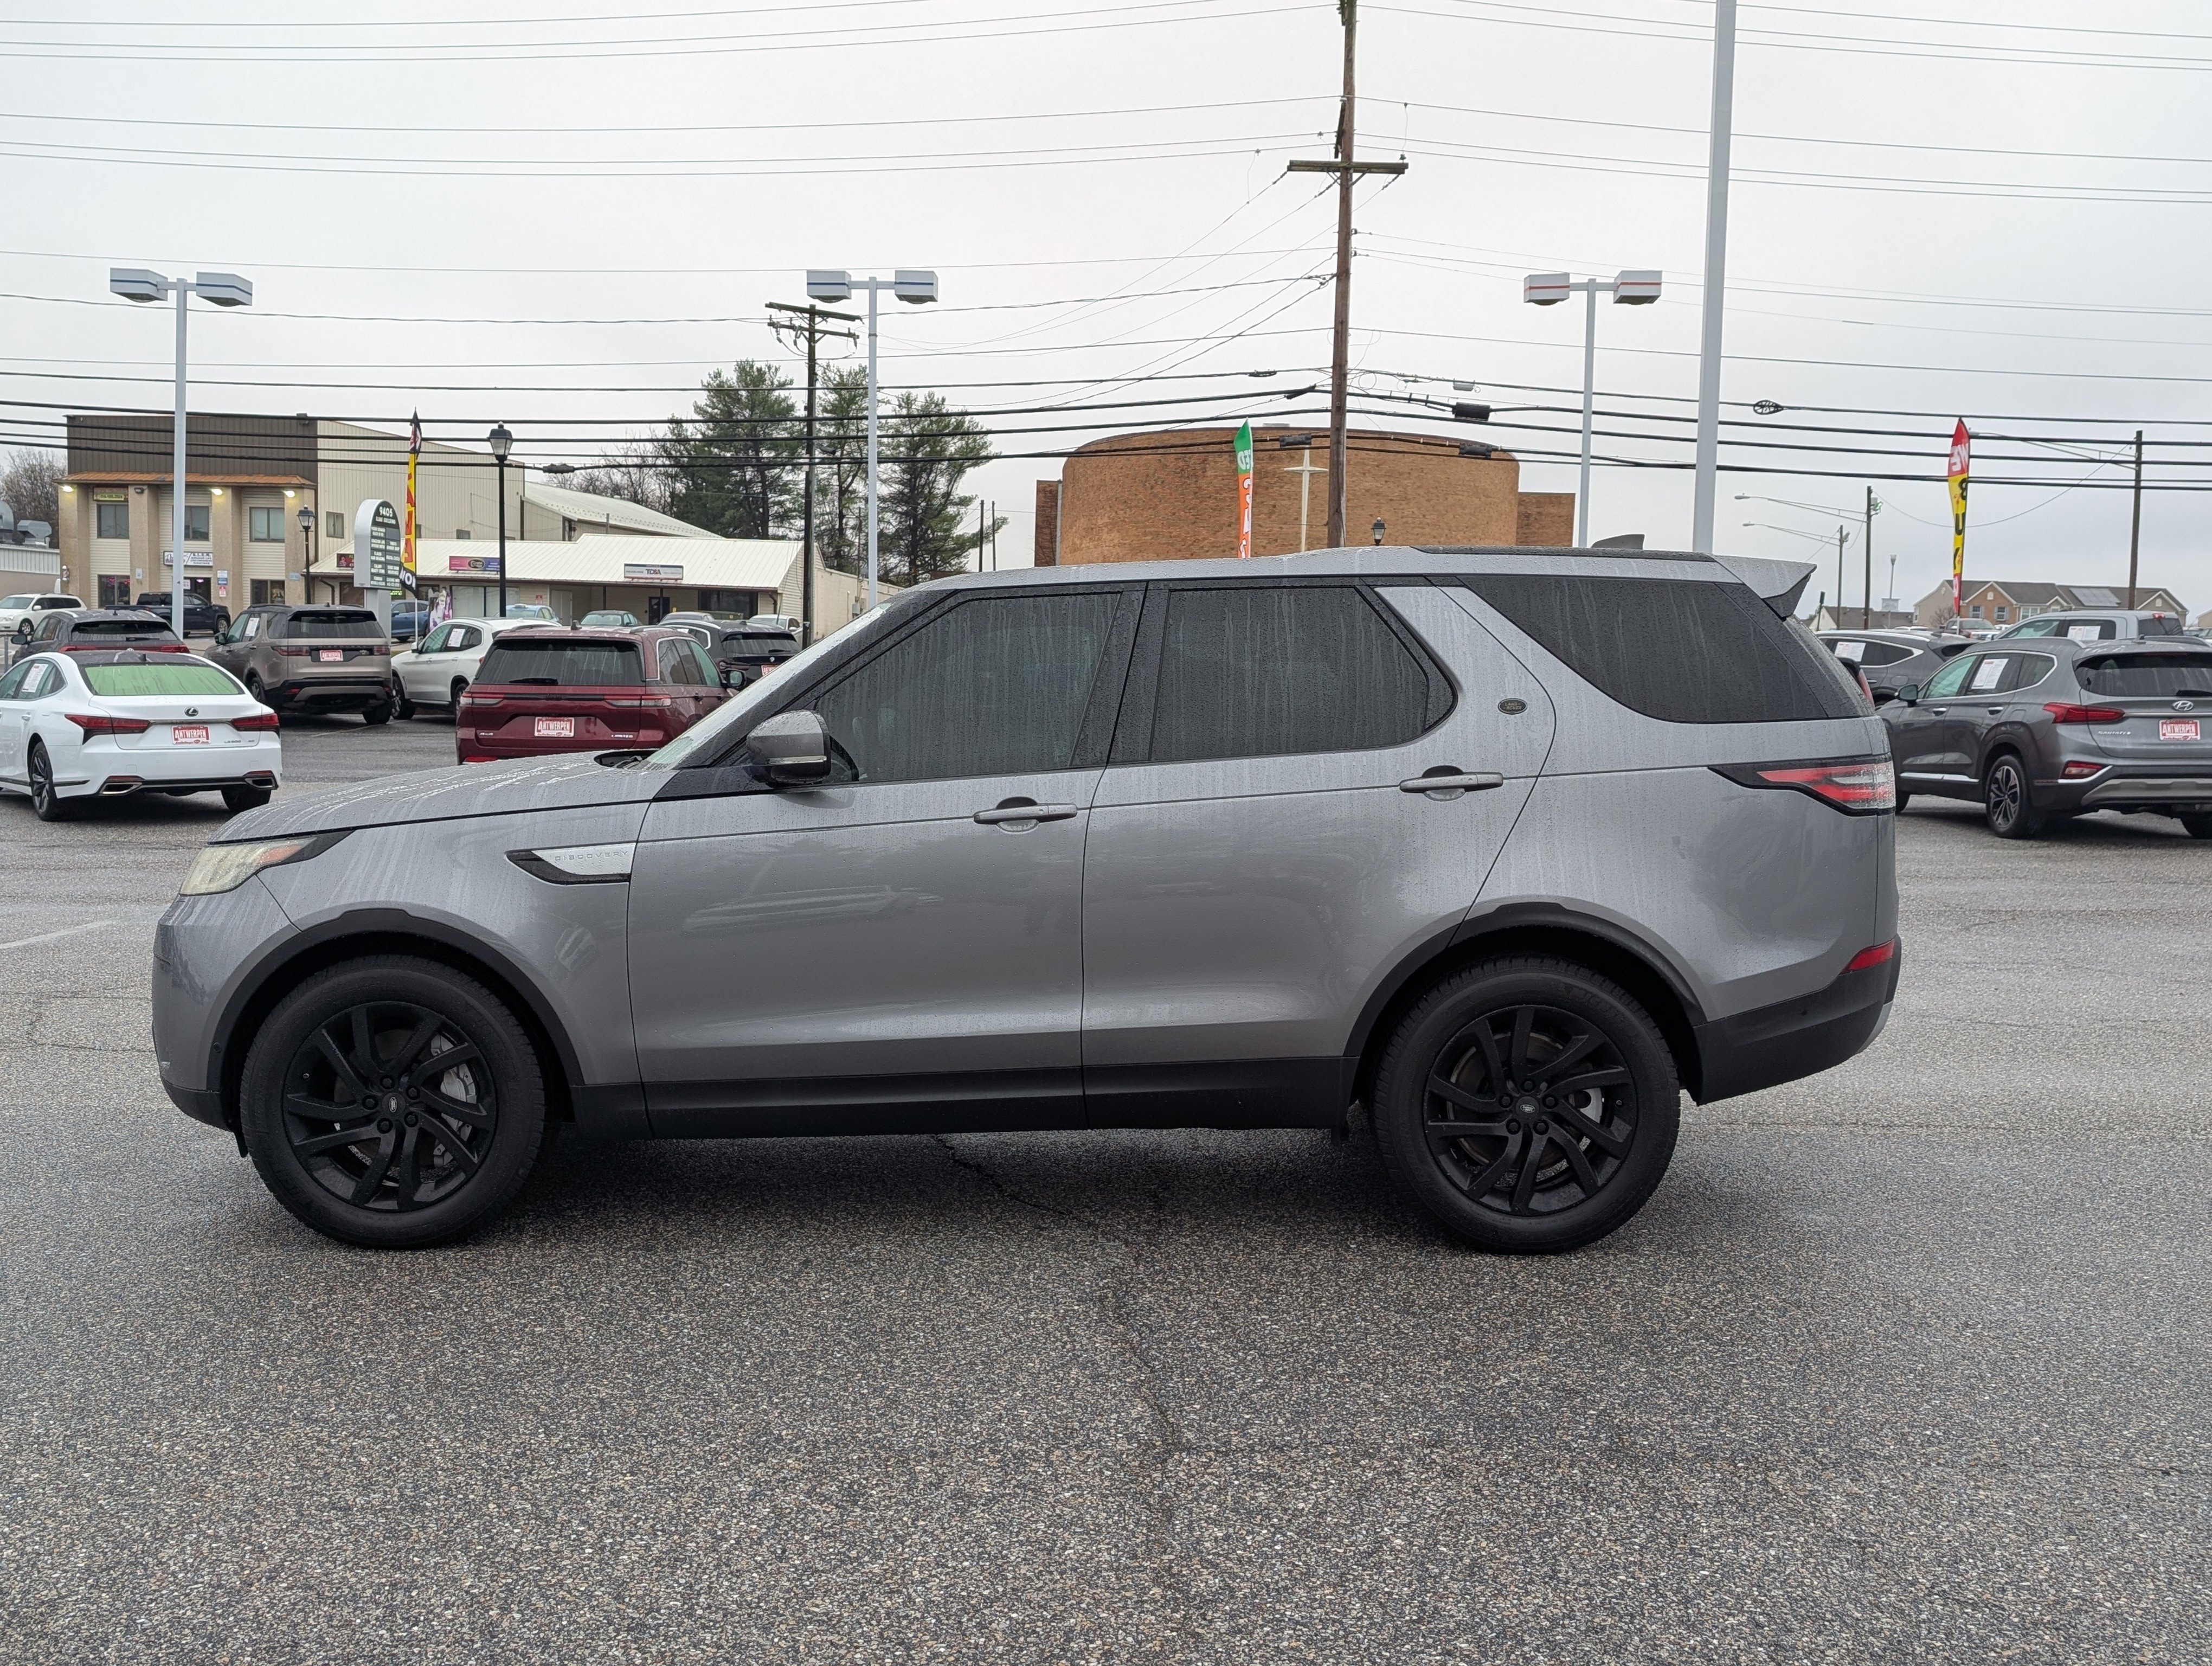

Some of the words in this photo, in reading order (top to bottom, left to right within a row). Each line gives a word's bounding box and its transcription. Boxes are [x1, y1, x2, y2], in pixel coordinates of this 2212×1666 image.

[379, 506, 393, 517] 9405
[537, 721, 570, 731] ANTWERPEN
[2162, 723, 2195, 734] ANTWERPEN
[175, 729, 206, 739] ANTWERPEN
[555, 851, 628, 861] DISCOVERY
